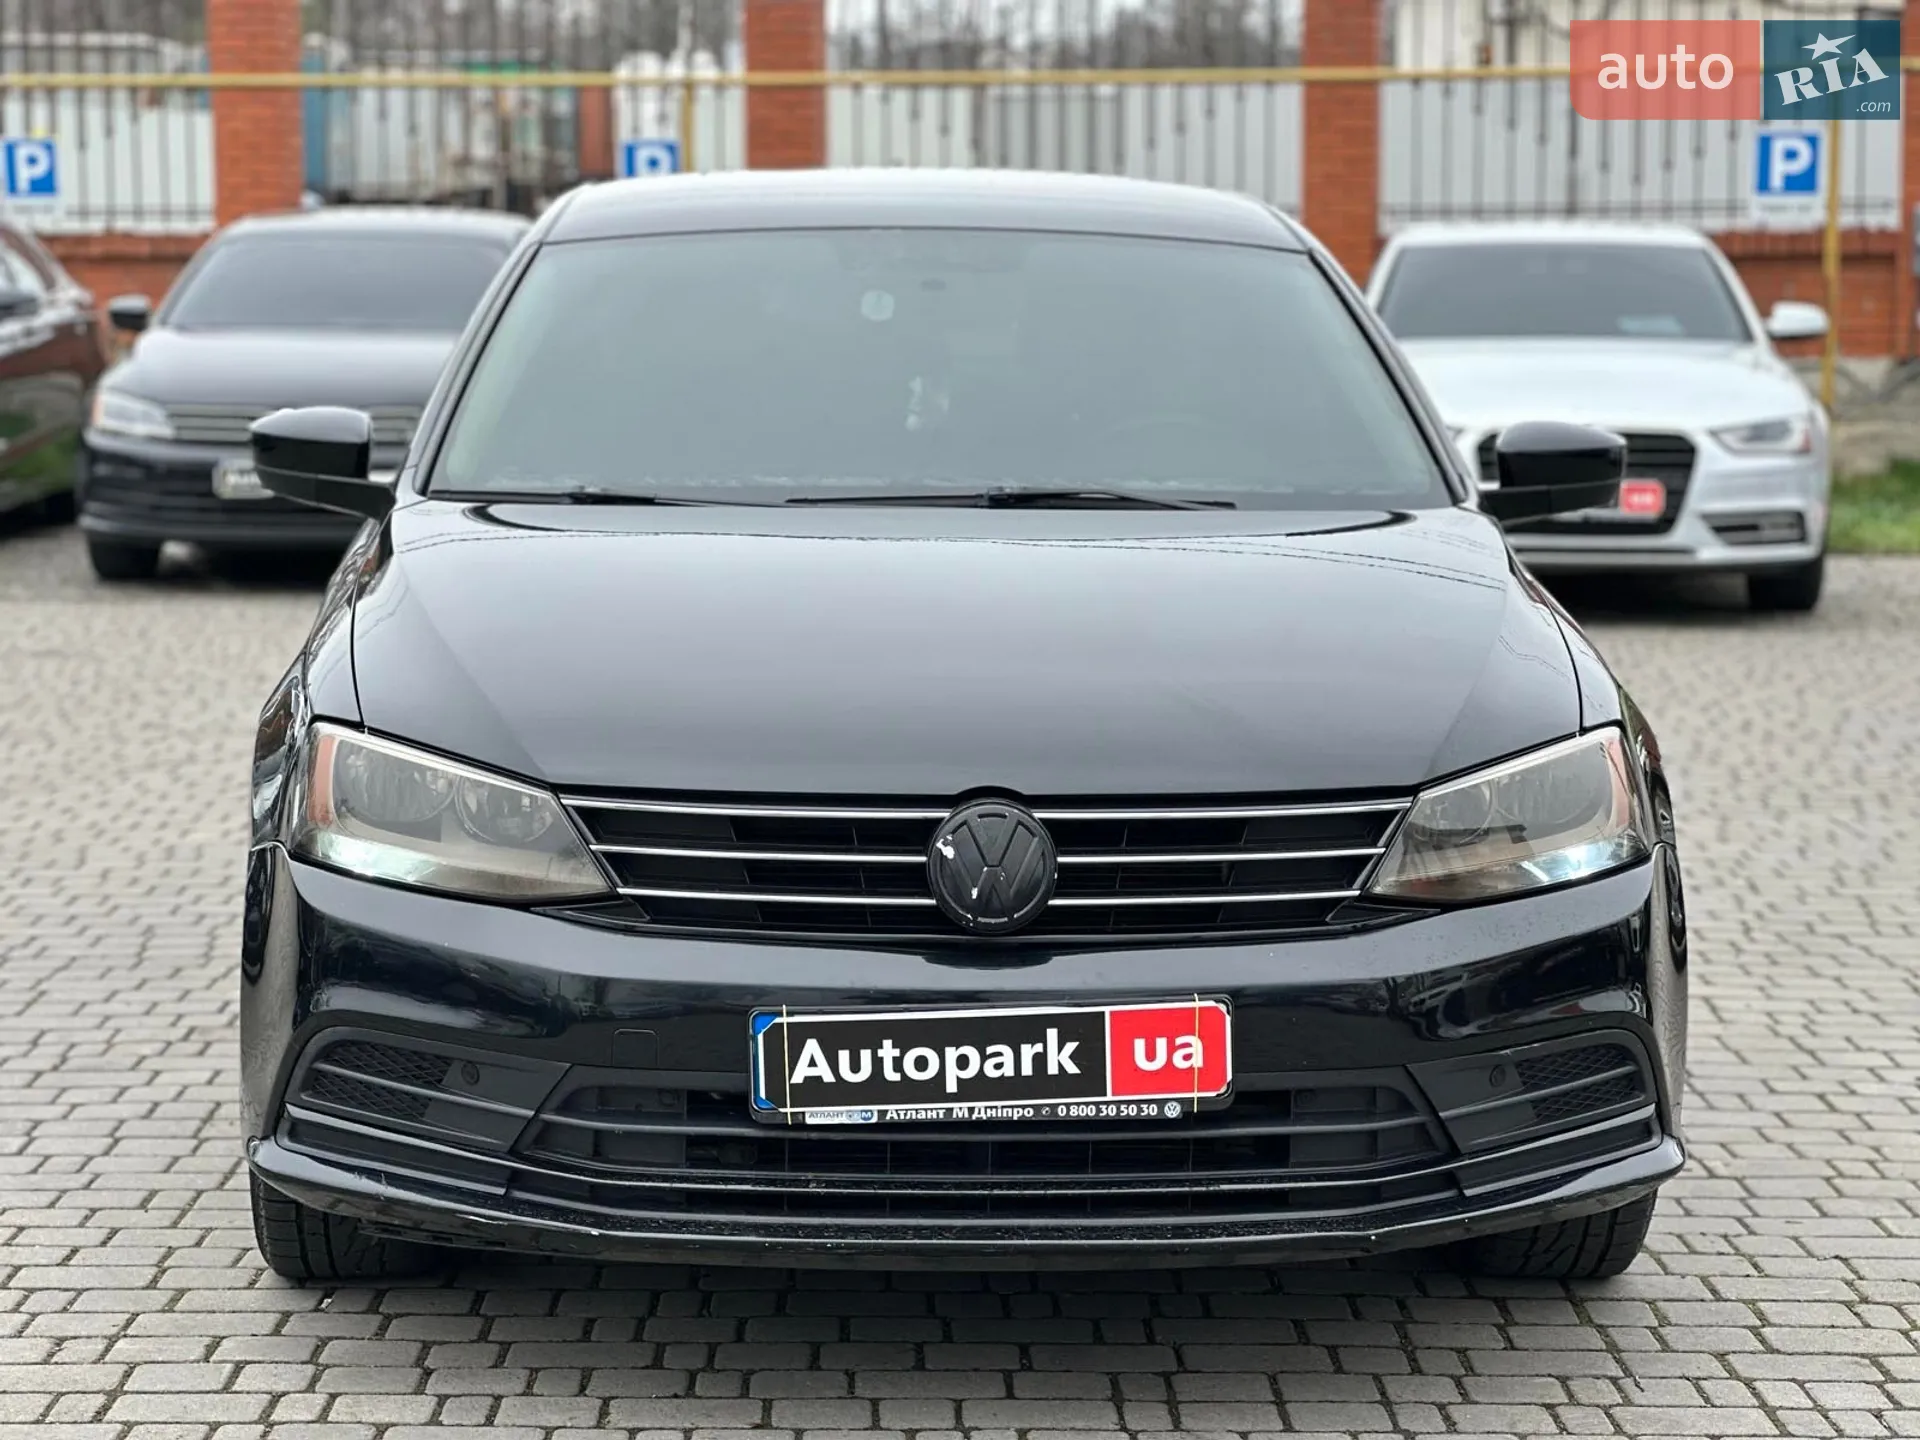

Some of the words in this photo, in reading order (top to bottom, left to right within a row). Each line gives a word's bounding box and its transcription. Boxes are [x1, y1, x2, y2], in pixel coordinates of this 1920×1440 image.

[15, 144, 50, 192] P
[1768, 136, 1814, 193] P
[789, 1027, 1082, 1094] Autopark
[1133, 1034, 1204, 1072] ua
[886, 1109, 946, 1120] Атлант
[972, 1106, 1034, 1120] Дніпро
[1057, 1105, 1067, 1116] 0
[1069, 1105, 1097, 1116] 800
[1099, 1104, 1117, 1116] 30
[1120, 1104, 1138, 1116] 50
[1140, 1103, 1158, 1115] 30
